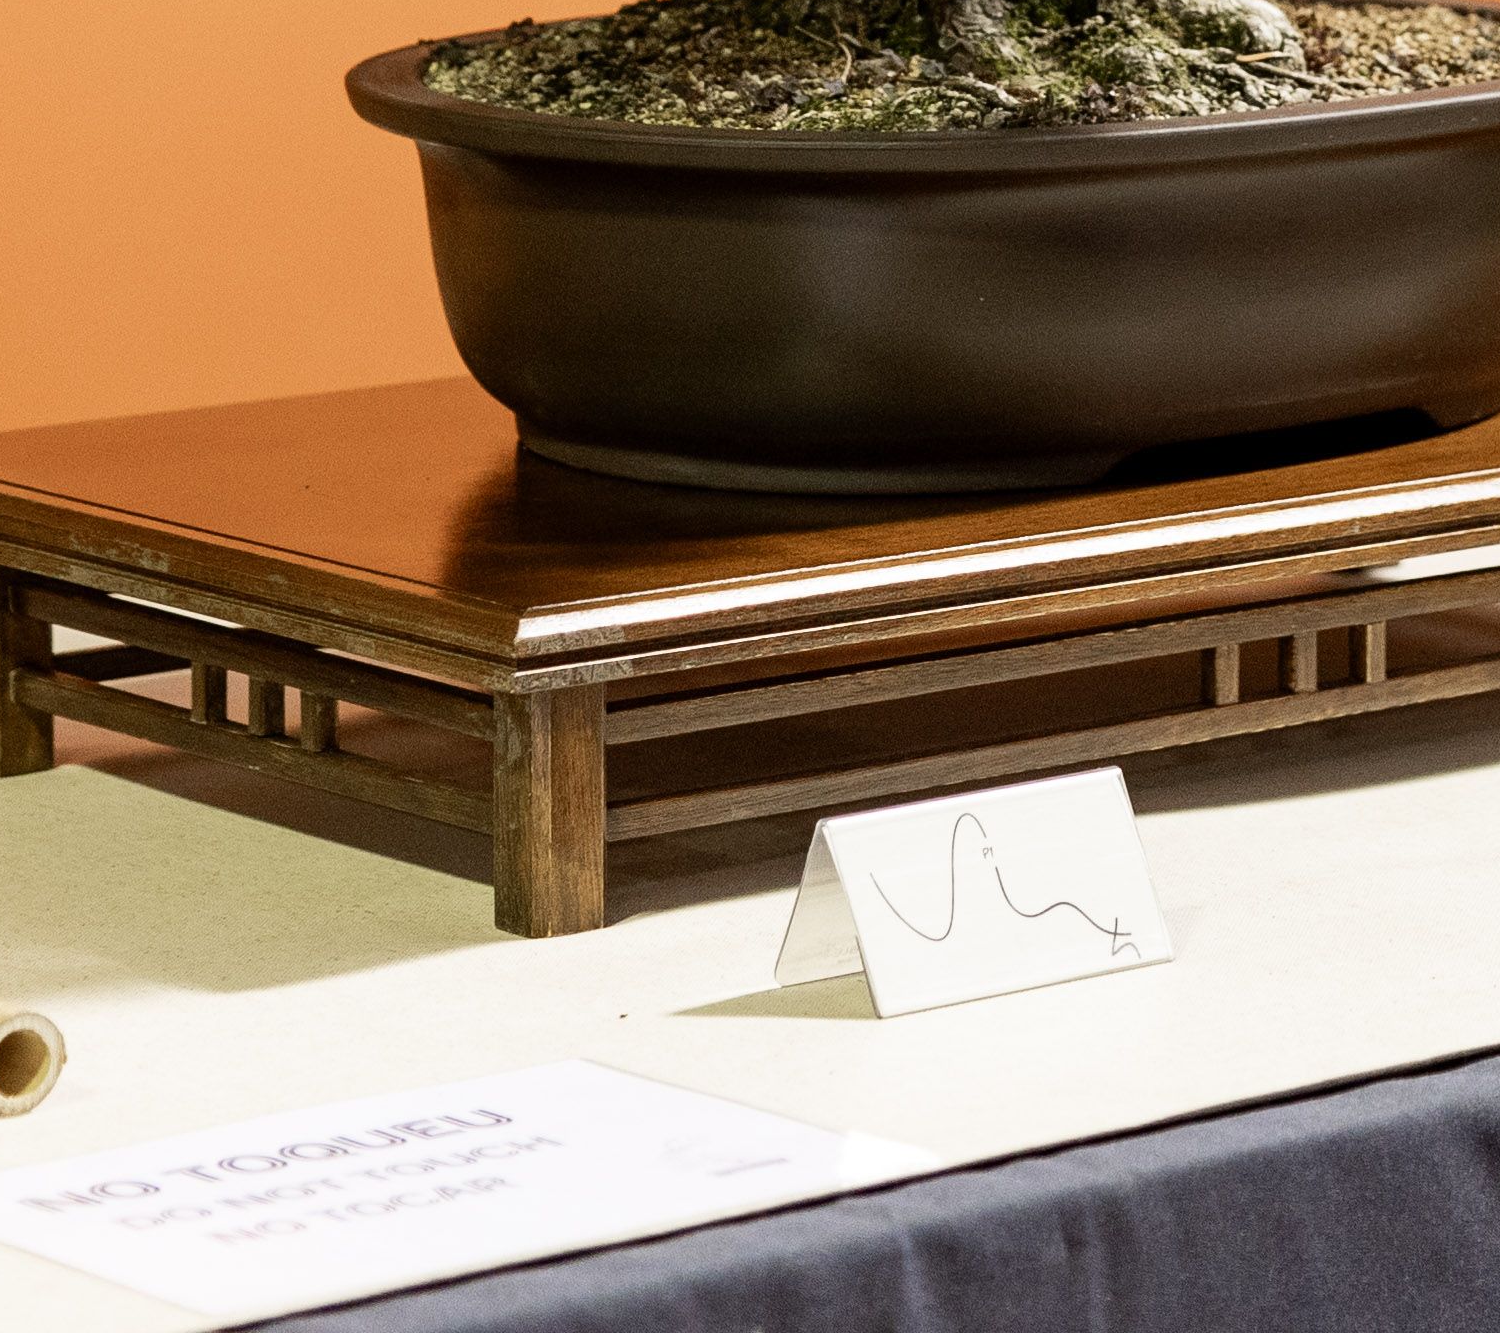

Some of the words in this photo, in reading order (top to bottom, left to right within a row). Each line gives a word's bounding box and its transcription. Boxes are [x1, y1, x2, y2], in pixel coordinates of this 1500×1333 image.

[17, 1179, 162, 1215] NO
[163, 1107, 515, 1184] TOQUEU
[115, 1206, 213, 1233] DO
[222, 1176, 345, 1212] NOT
[355, 1132, 566, 1182] TOUCH
[206, 1218, 309, 1246] NO
[316, 1174, 515, 1223] TOCAR
